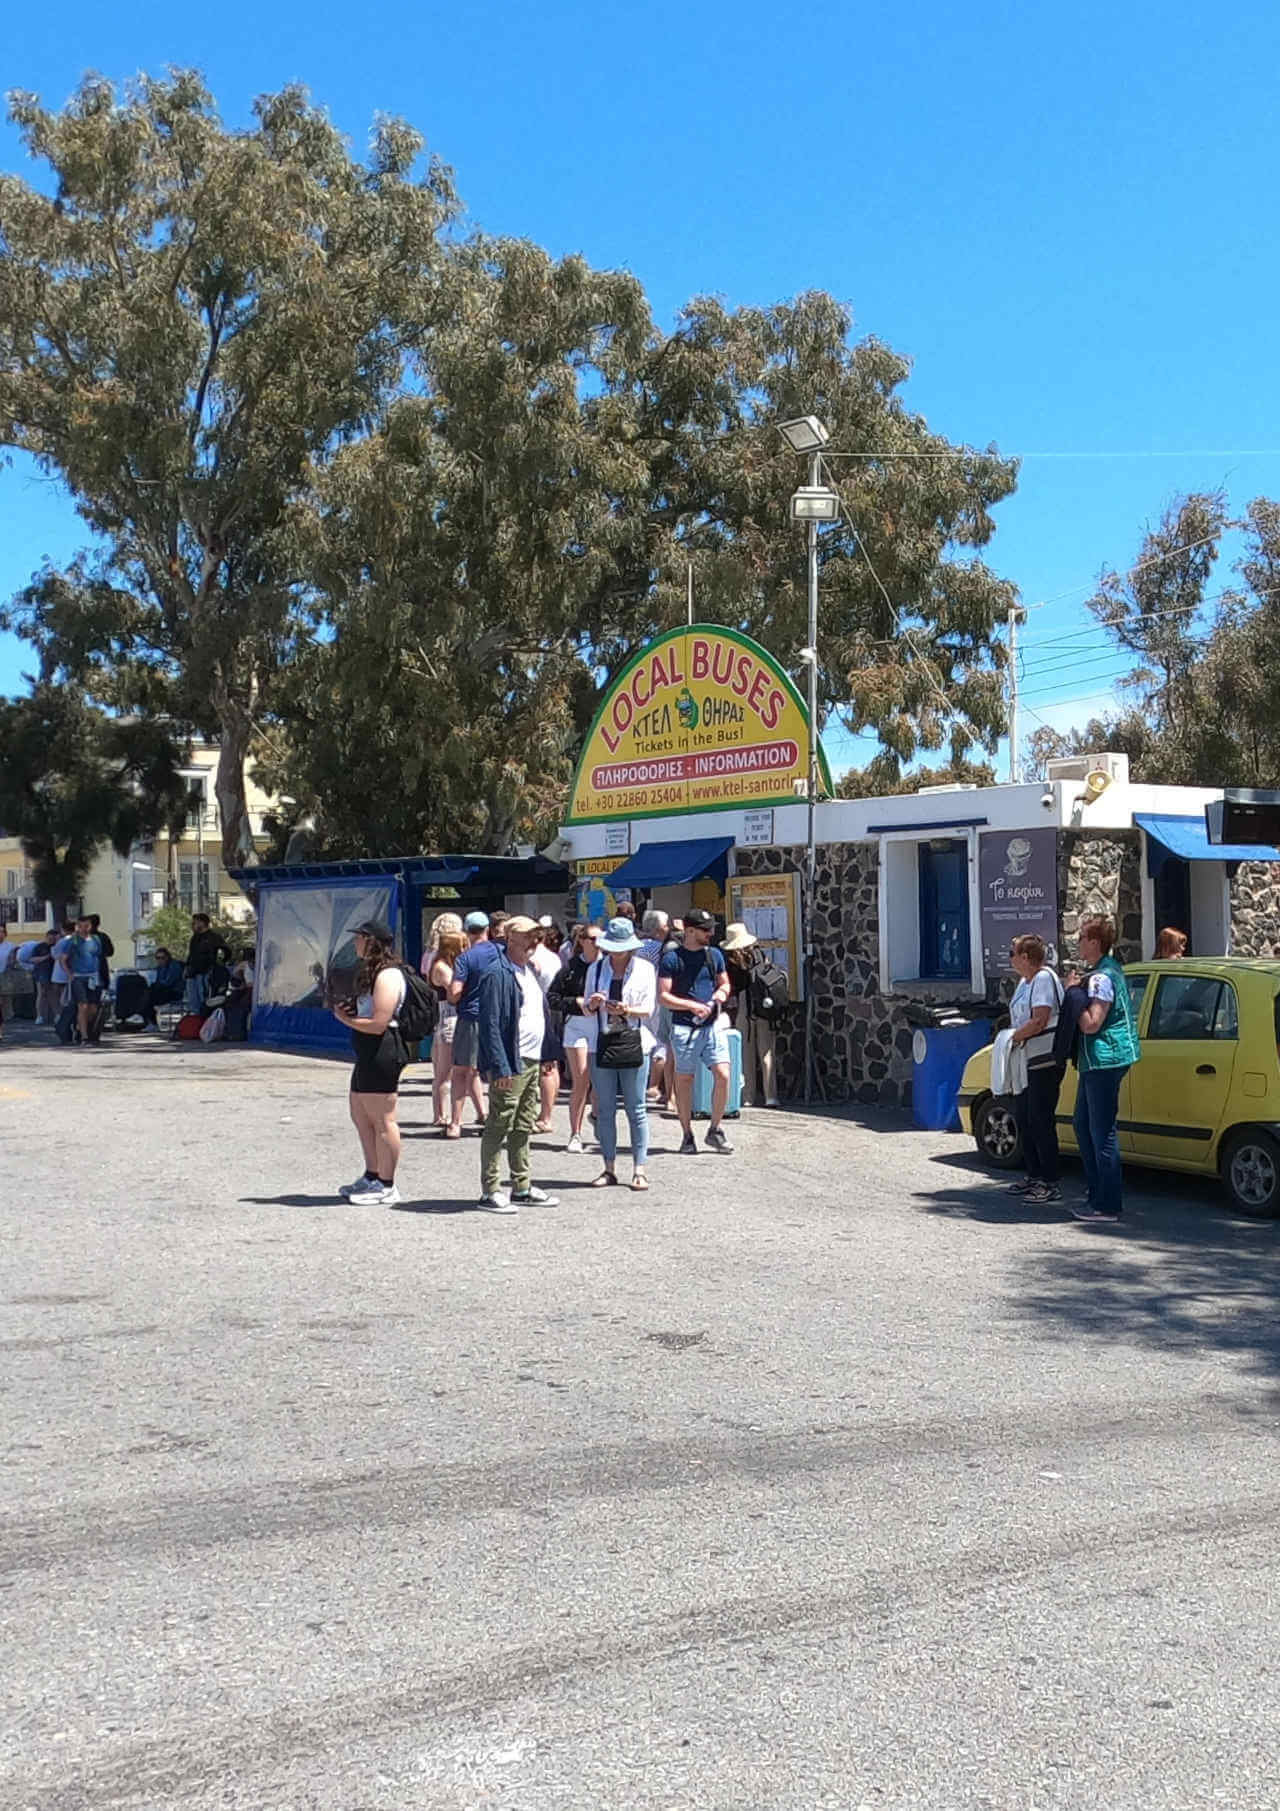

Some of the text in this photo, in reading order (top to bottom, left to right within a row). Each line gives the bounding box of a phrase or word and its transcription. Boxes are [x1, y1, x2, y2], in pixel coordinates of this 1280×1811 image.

[600, 641, 785, 753] LOCAL BUSES
[632, 696, 745, 739] ΚΤΕΛ ΘΗΡΑΣ
[635, 727, 744, 754] Tickets in the Bus!
[596, 761, 684, 787] ΠΛΗΡΟΦΟΡΙΕΣ
[695, 746, 790, 774] INFORMATION
[576, 796, 593, 813] tel.
[596, 795, 614, 810] +30
[617, 788, 648, 807] 22860
[651, 786, 683, 805] 25404
